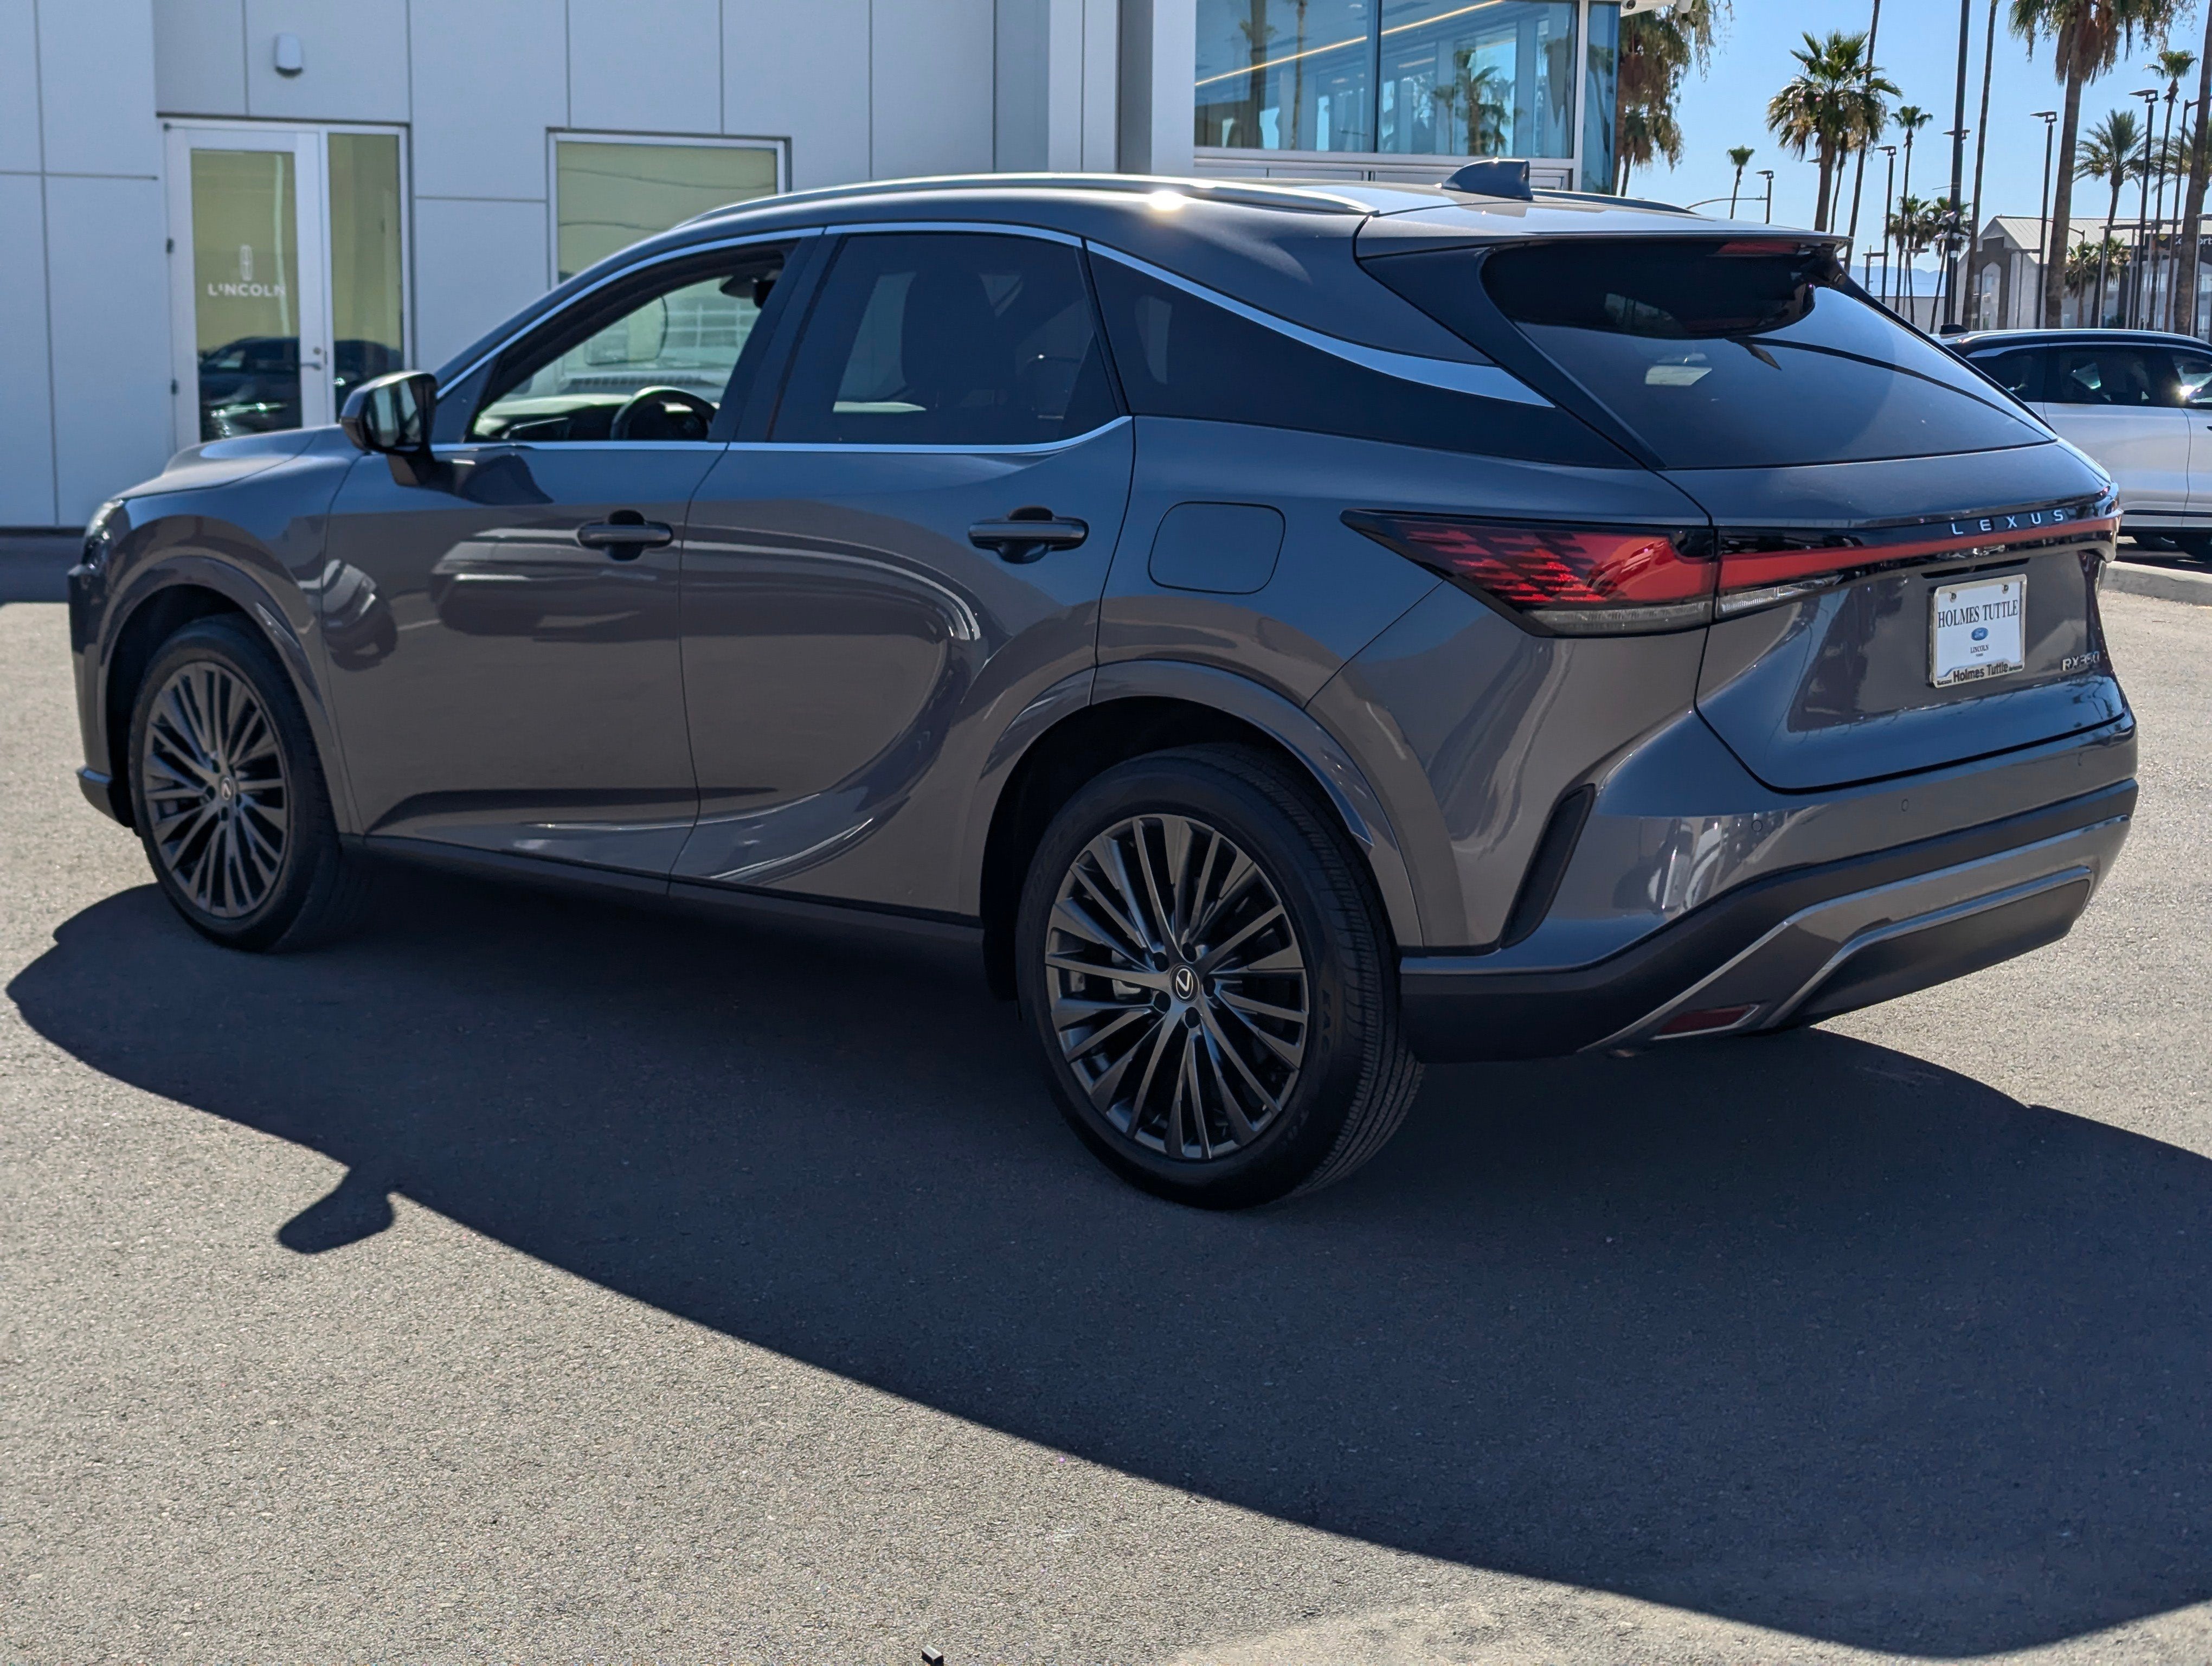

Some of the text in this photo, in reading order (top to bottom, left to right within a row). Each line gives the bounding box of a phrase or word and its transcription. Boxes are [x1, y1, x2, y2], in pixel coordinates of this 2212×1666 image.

[208, 284, 286, 296] LINCOLN
[1952, 510, 2064, 535] LEXUS
[1938, 599, 2018, 628] HOLMES TUTTLE
[1953, 669, 1985, 682] Holmes
[1986, 662, 2008, 676] Tuttle
